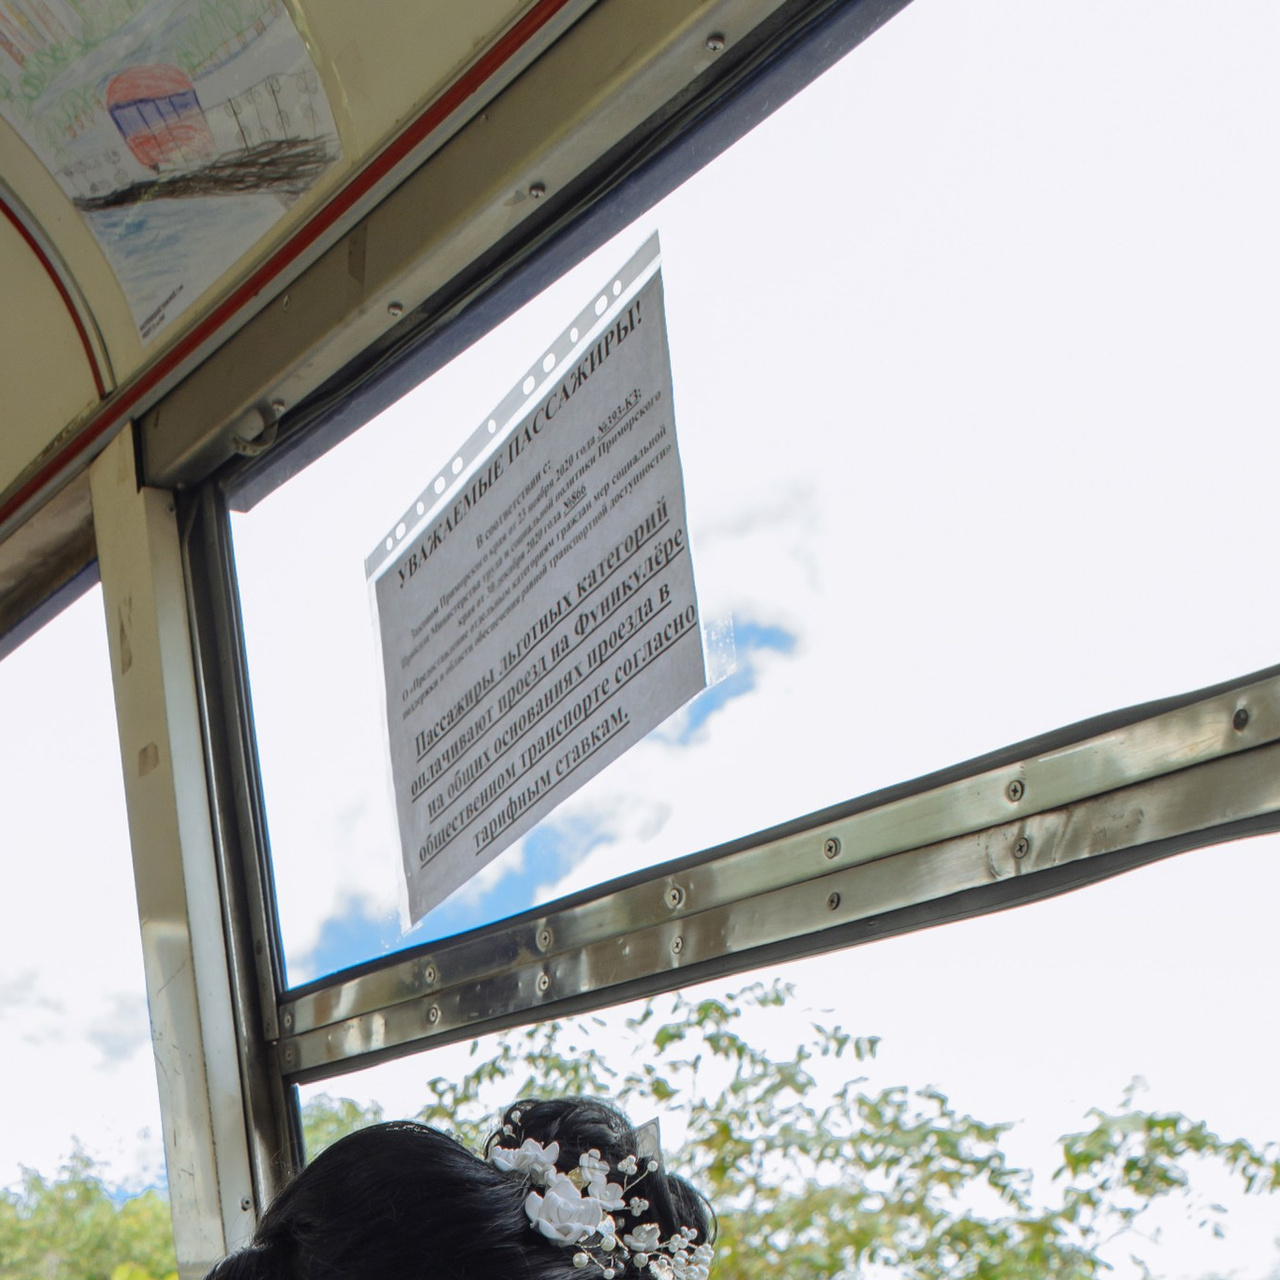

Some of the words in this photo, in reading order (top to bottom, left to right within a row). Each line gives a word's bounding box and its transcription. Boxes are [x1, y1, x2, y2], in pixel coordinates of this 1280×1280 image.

[397, 453, 503, 588] УВАЖАЕМЫЕ
[508, 300, 641, 464] ПАССАЖИРЫ!
[475, 533, 483, 549] В
[484, 470, 541, 540] соответствии
[542, 459, 550, 474] с:
[512, 537, 554, 589] категориям
[556, 500, 591, 541] граждан
[593, 482, 609, 501] мер
[611, 423, 666, 484] социальной
[521, 563, 547, 602] равной
[549, 502, 607, 568] транспортной
[609, 444, 671, 509] доступности»
[527, 478, 554, 513] ноября
[555, 453, 573, 481] 2020
[575, 435, 595, 460] года
[555, 454, 595, 502] политики
[597, 390, 661, 457] Приморского
[415, 668, 494, 756] Пассажиры
[499, 592, 572, 675] льготных
[576, 495, 667, 598] категорий
[457, 604, 475, 626] края
[476, 594, 484, 607] от
[526, 527, 542, 553] 2020
[543, 511, 561, 533] года
[410, 706, 492, 796] оплачивают
[497, 655, 547, 718] проезд
[550, 634, 569, 662] на
[574, 528, 684, 635] Фуникулёре
[419, 762, 515, 861] общественном
[520, 677, 609, 768] транспорте
[614, 604, 694, 684] согласно
[427, 793, 444, 817] на
[447, 748, 490, 798] общих
[493, 662, 582, 754] основаниях
[587, 597, 653, 668] проезда
[658, 583, 669, 603] в
[474, 769, 551, 848] тарифным
[555, 706, 628, 776] ставкам.
